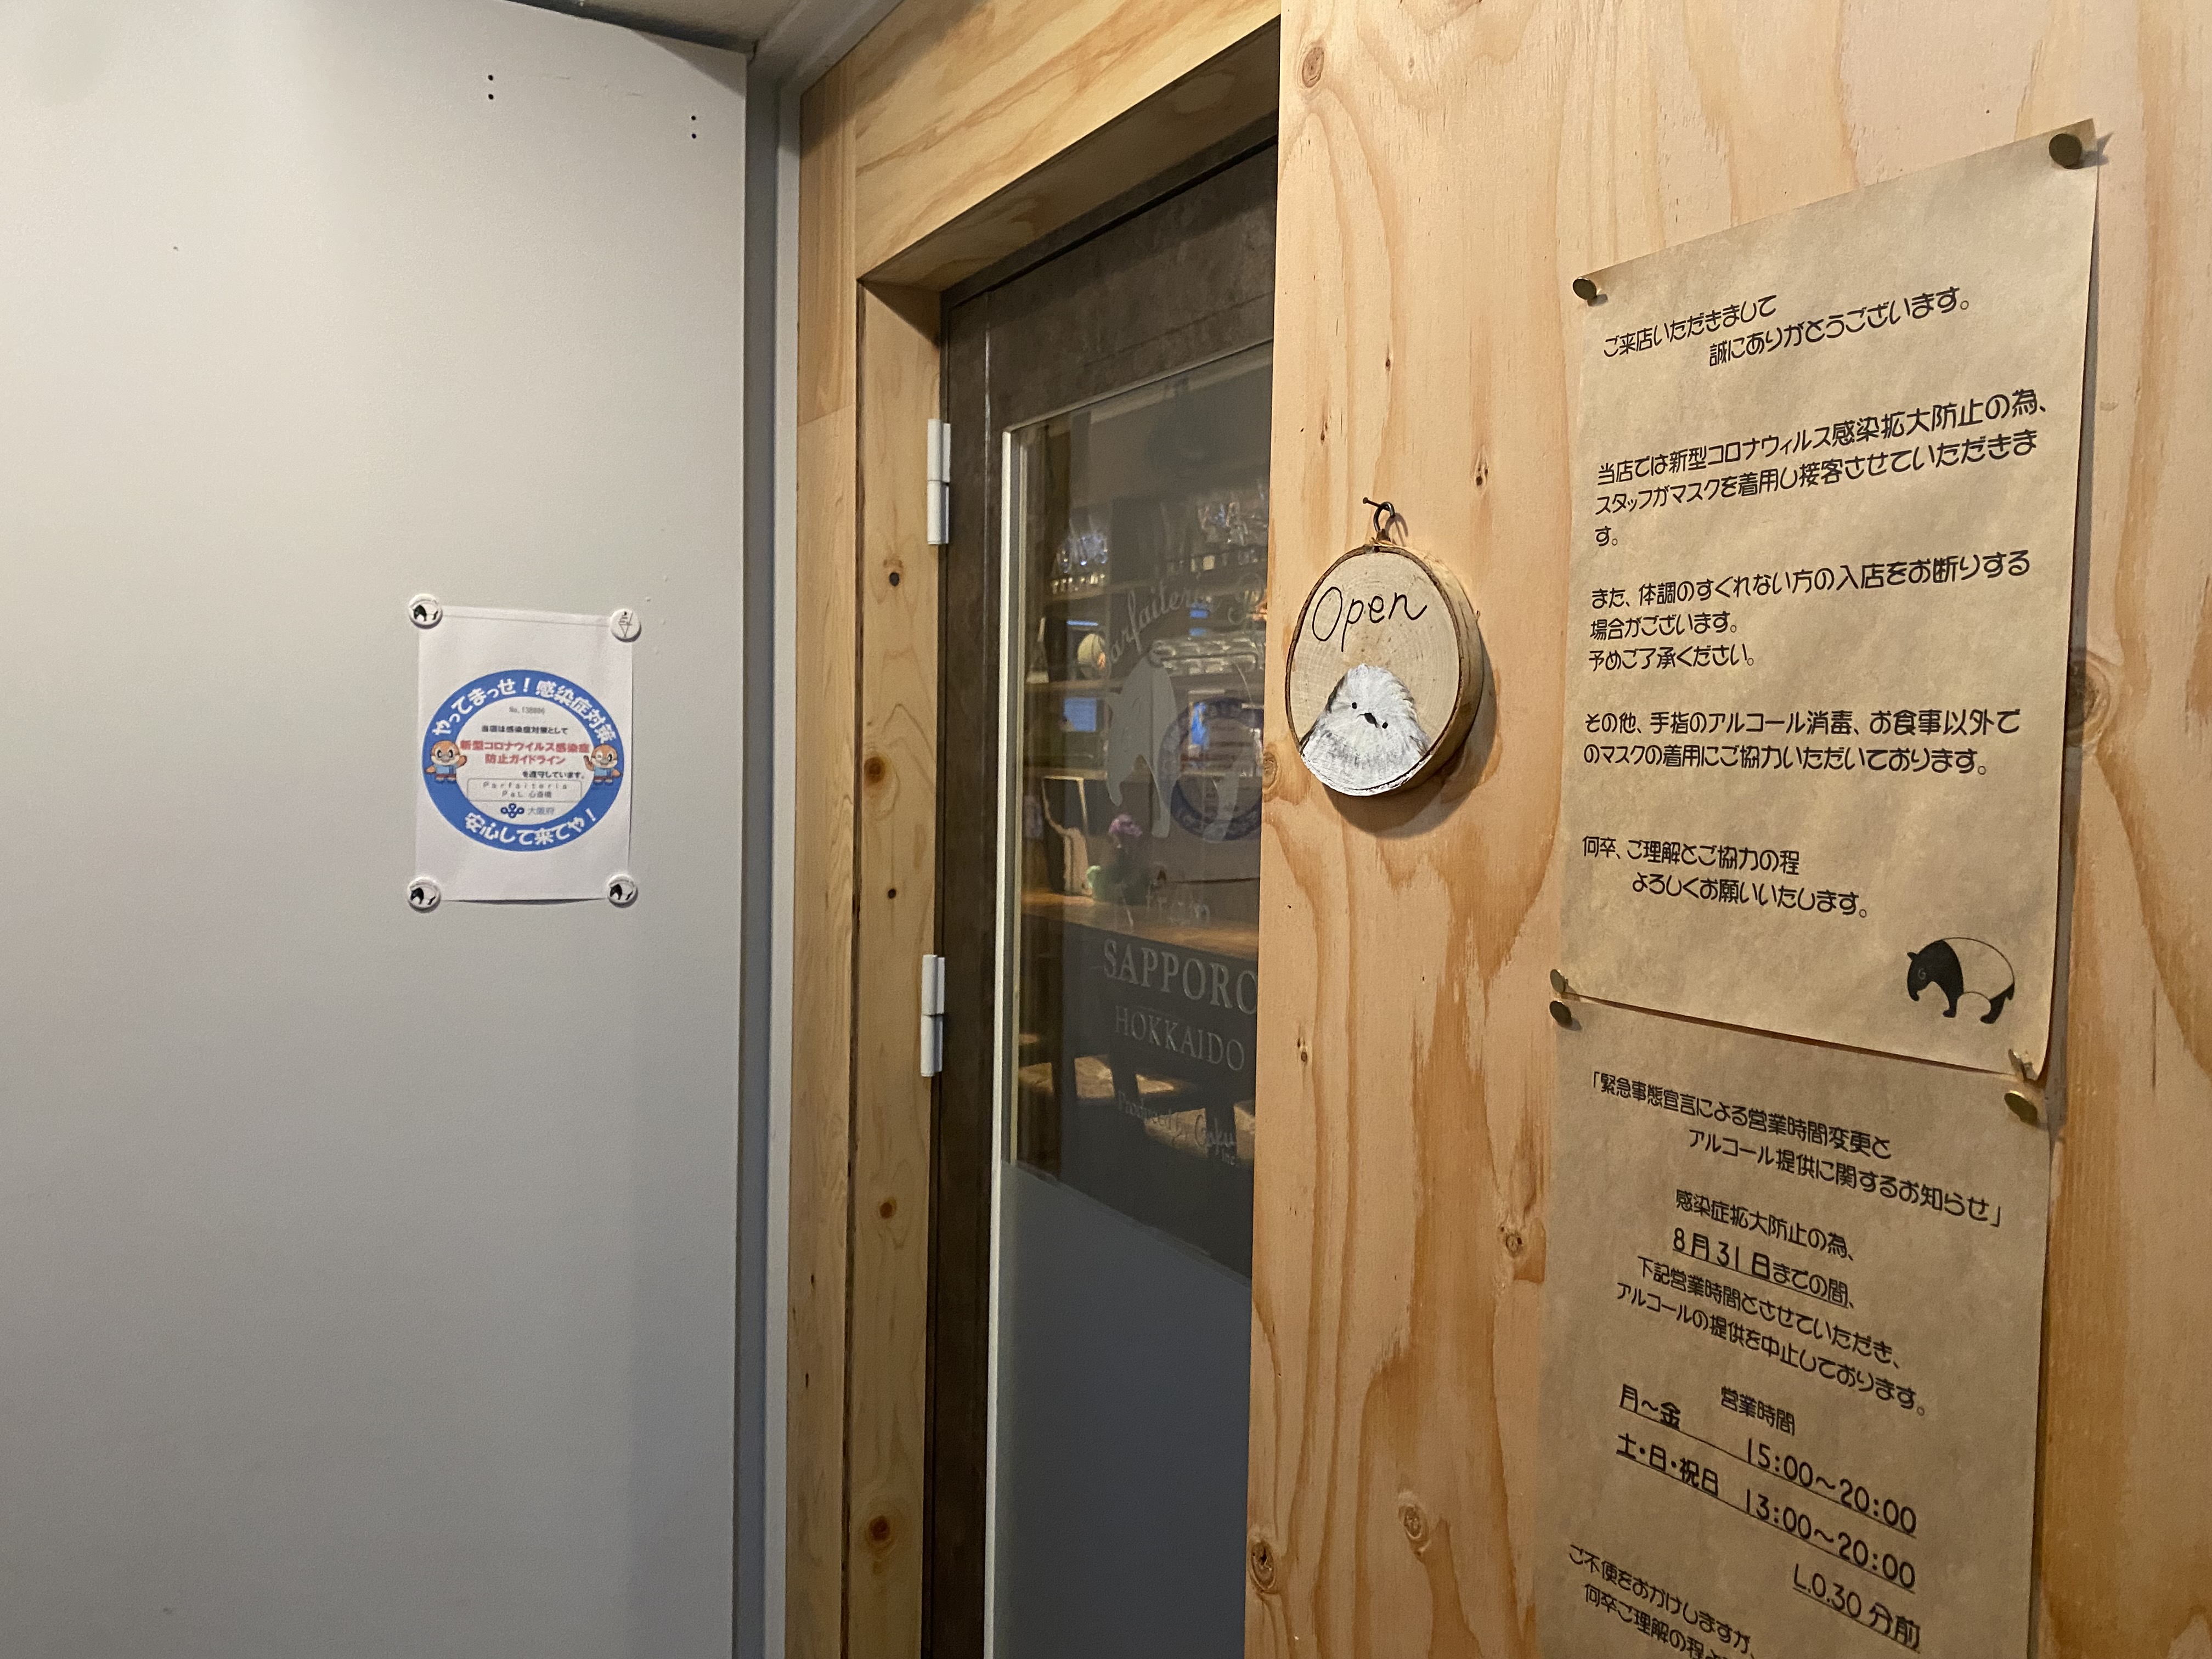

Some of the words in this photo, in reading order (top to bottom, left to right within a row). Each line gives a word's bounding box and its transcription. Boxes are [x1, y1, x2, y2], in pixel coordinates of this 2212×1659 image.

[1603, 295, 1777, 358] ご来店いただきまして
[1709, 286, 1970, 367] 誠にありがとうございます。
[1598, 389, 2047, 486] 当店では新型コロナウィルス感染拡大防止の為、
[1595, 429, 2038, 515] スタッフがマスクを着用し接客させていただきま
[1595, 526, 1618, 548] す。
[1312, 586, 1427, 652] Open
[1590, 610, 1737, 640] 場合がございます。
[1589, 644, 1754, 672] 予めご了承ください。
[460, 740, 589, 753] 新型コロナウイルス感染症
[485, 753, 565, 765] 防止ガイドライン
[1583, 744, 1987, 776] のマスクの着用にご協力いただいております。
[1582, 835, 1799, 875] 何卒、ご理解とご協力の程
[1632, 873, 1867, 918] よろしくお願いいたします。
[1104, 939, 1257, 1015] SAPPORO
[1115, 1005, 1244, 1071] HOKKAIDO
[1592, 1070, 1891, 1160] 「緊急事態宣言による営業時間変更と
[1688, 1128, 2002, 1228] アルコール提供に関するお知らせ」
[1675, 1189, 1855, 1261] 感染症拡大防止の為、
[1637, 1255, 1902, 1369] 下記営業時間とさせていただき、
[1616, 1282, 1926, 1417] アルコールの提供を中止しております。
[1720, 1386, 1796, 1436] 営業時間
[1584, 1583, 1729, 1659] 何卒ご理解の程
